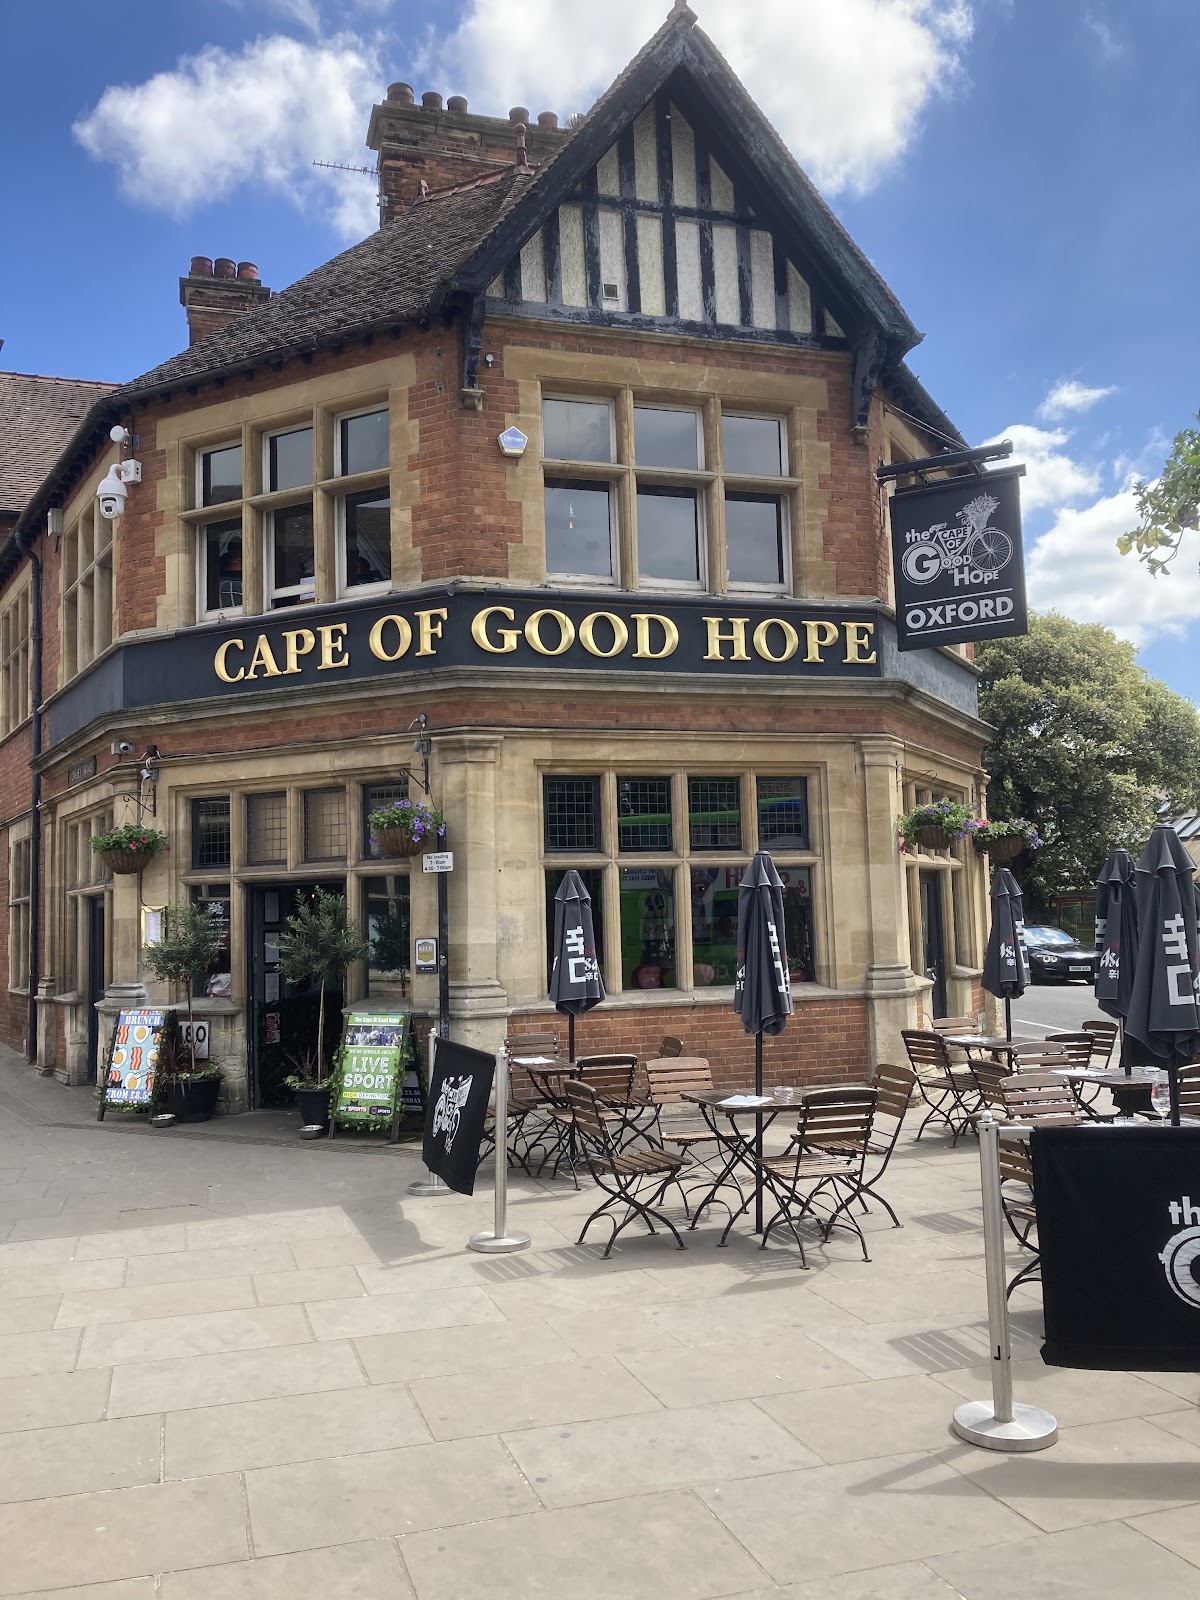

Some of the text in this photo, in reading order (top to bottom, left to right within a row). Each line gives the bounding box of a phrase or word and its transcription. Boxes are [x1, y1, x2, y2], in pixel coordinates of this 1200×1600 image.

[905, 528, 930, 544] the
[942, 527, 969, 540] CAPE
[947, 539, 962, 549] OF
[906, 546, 972, 581] GOOD
[953, 567, 999, 587] HOPE
[905, 596, 1014, 629] OXFORD
[214, 606, 877, 683] CAPE OF GOOD HOPE
[125, 1015, 160, 1025] BRUNCH
[351, 1056, 390, 1073] LIVE
[343, 1074, 394, 1089] SPORT
[106, 1090, 128, 1099] FROM
[348, 1105, 367, 1113] SPORTS
[1168, 1195, 1200, 1225] th
